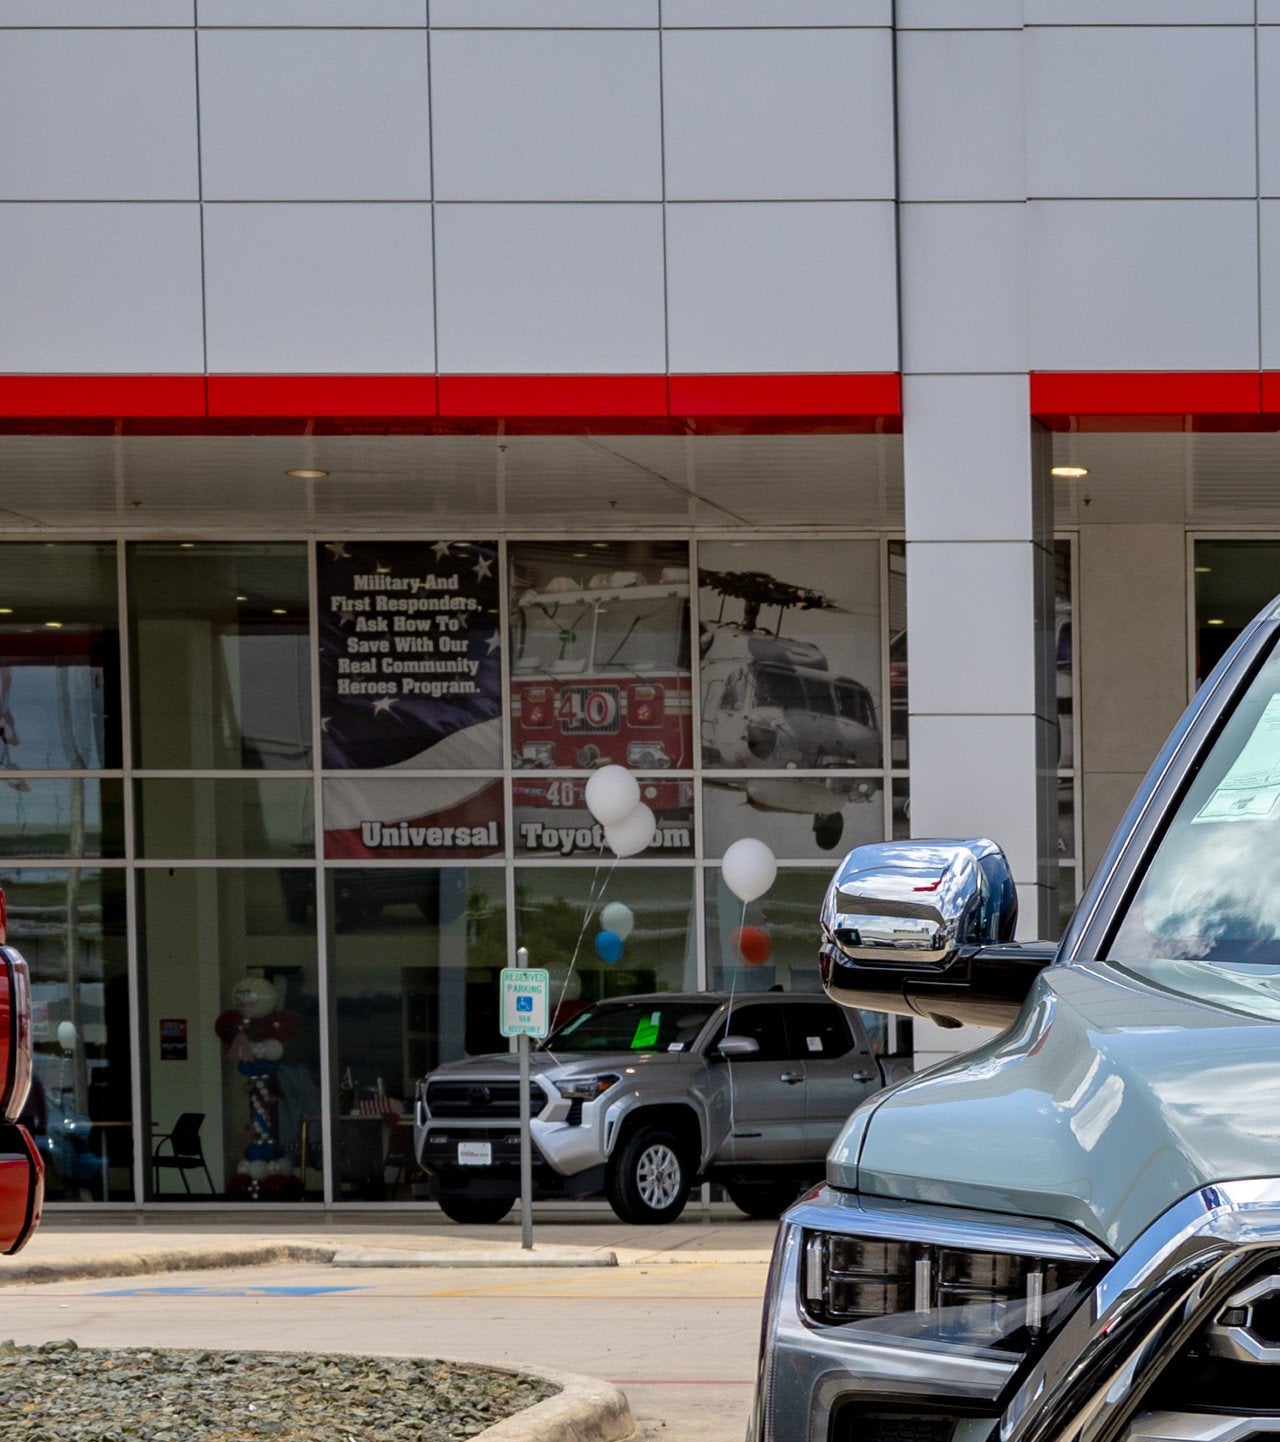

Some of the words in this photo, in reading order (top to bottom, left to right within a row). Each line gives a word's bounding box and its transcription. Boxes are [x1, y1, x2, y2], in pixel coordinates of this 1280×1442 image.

[354, 574, 420, 593] Military
[425, 574, 459, 589] And
[331, 596, 371, 611] First
[375, 595, 482, 614] Responders,
[355, 616, 388, 632] Ask
[393, 616, 431, 631] How
[436, 615, 459, 631] To
[347, 637, 390, 653] Save
[394, 637, 433, 652] With
[439, 636, 469, 652] Our
[338, 658, 377, 673] Real
[382, 657, 479, 675] Community
[337, 679, 397, 694] Heroes
[402, 678, 480, 697] Program.
[557, 691, 615, 727] 40
[547, 781, 574, 806] 40
[361, 821, 499, 847] Universal
[505, 973, 545, 982] RESERVED
[508, 985, 542, 994] PARKING
